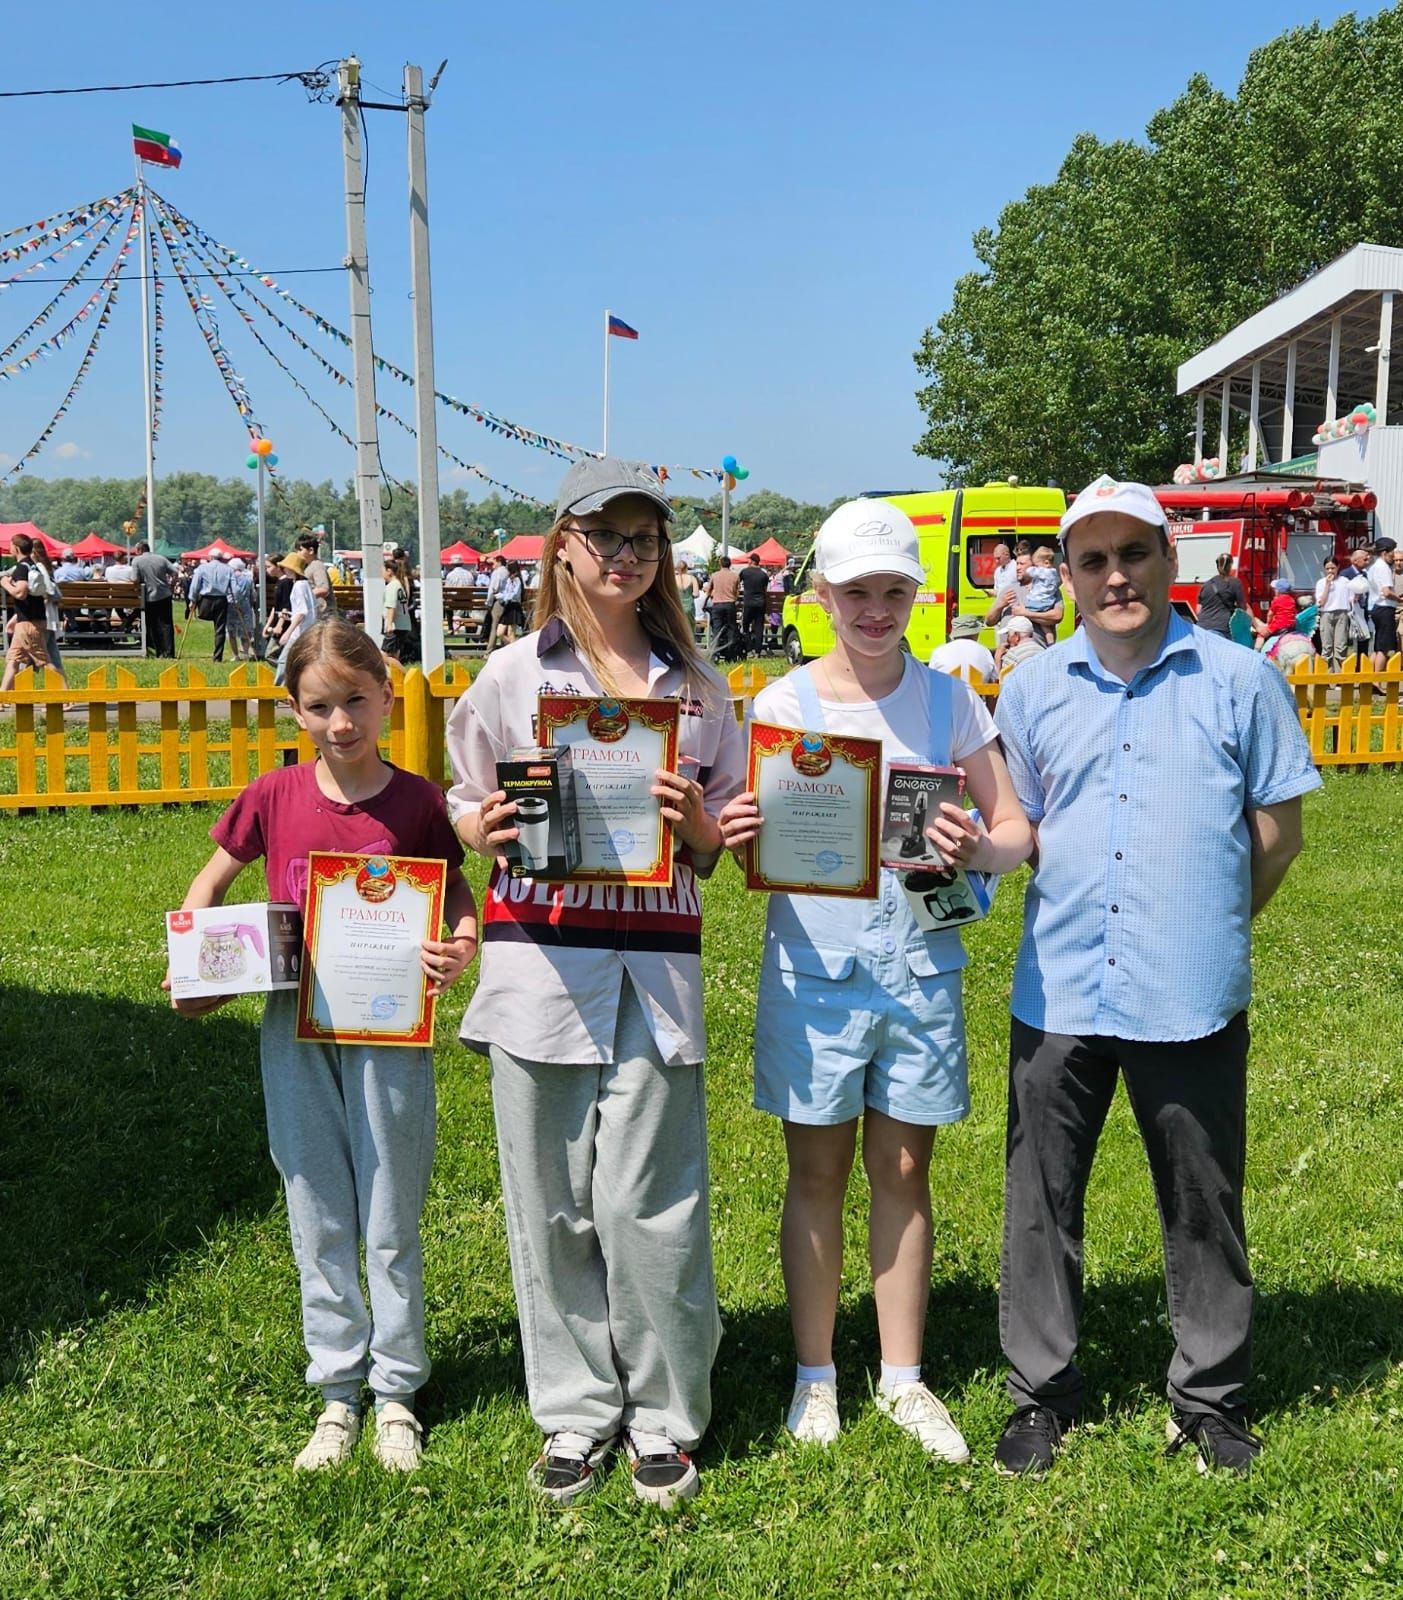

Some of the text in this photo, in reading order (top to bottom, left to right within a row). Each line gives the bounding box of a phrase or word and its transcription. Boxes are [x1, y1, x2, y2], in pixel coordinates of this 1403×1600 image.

[1344, 536, 1368, 550] 102
[573, 749, 641, 763] ГРАМОТА
[503, 780, 553, 788] ТЕРМОКРУЖКА
[777, 779, 845, 795] ГРАМОТА
[340, 907, 407, 924] ГРАМОТА
